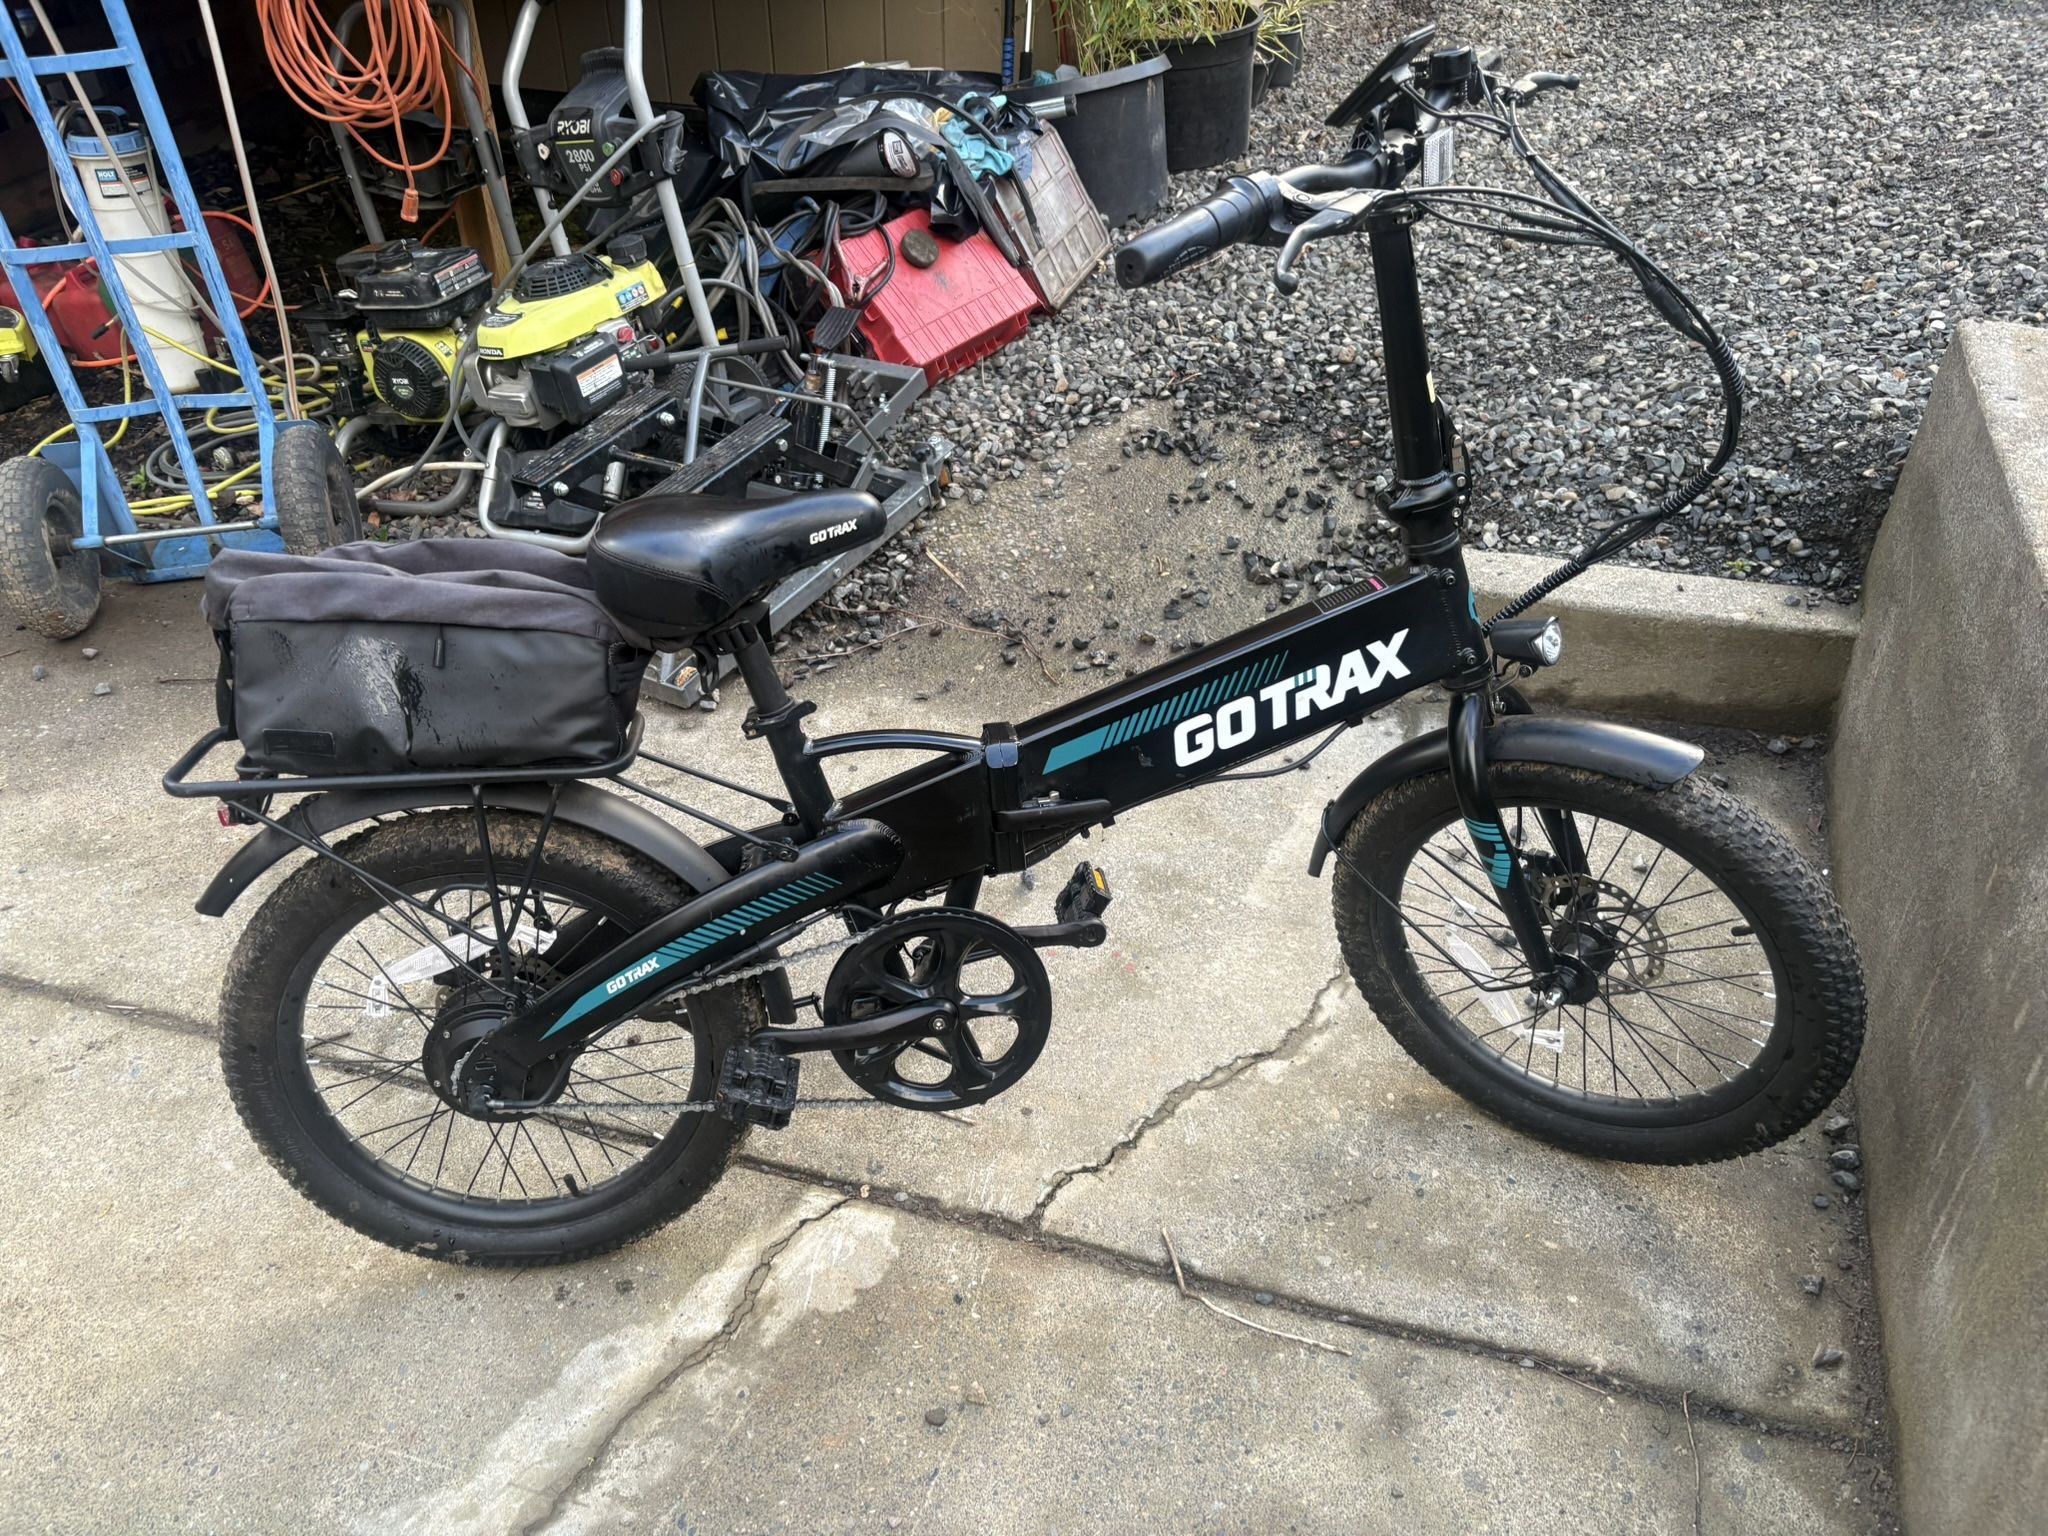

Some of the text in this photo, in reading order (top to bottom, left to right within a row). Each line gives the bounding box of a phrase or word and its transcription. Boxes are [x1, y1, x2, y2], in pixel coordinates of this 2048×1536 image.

[557, 119, 591, 135] RYOBI
[565, 149, 595, 163] 2800
[578, 163, 592, 172] PSI
[480, 348, 503, 356] HONDA
